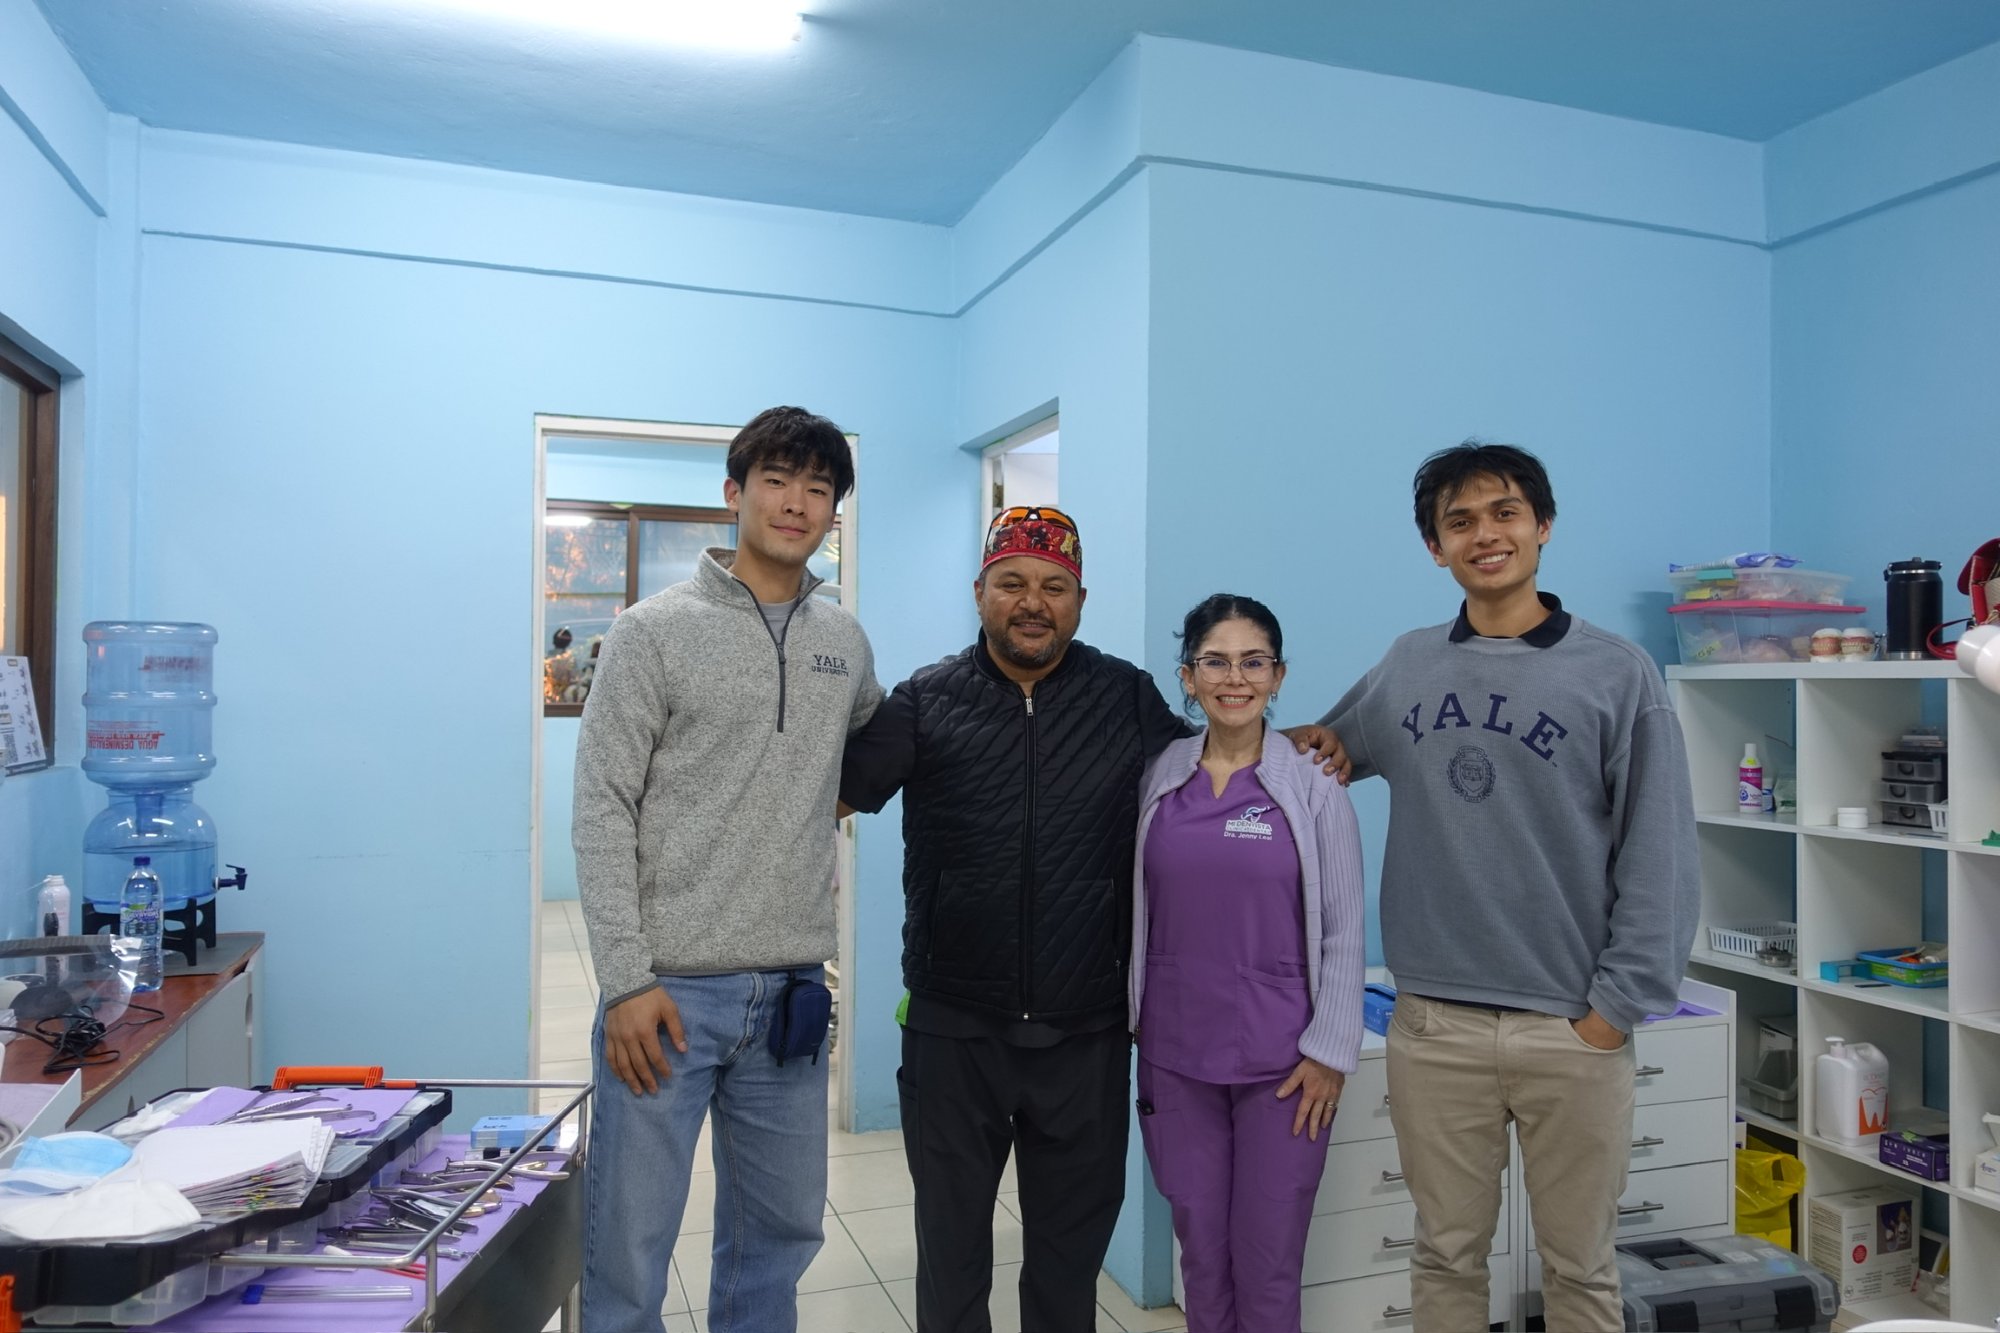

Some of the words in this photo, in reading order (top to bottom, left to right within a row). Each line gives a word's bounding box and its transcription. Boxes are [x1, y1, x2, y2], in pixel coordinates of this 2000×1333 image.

[813, 654, 847, 670] YALE
[1401, 693, 1569, 761] YALE
[138, 740, 158, 749] AGUA
[1236, 821, 1270, 830] DENTISTA
